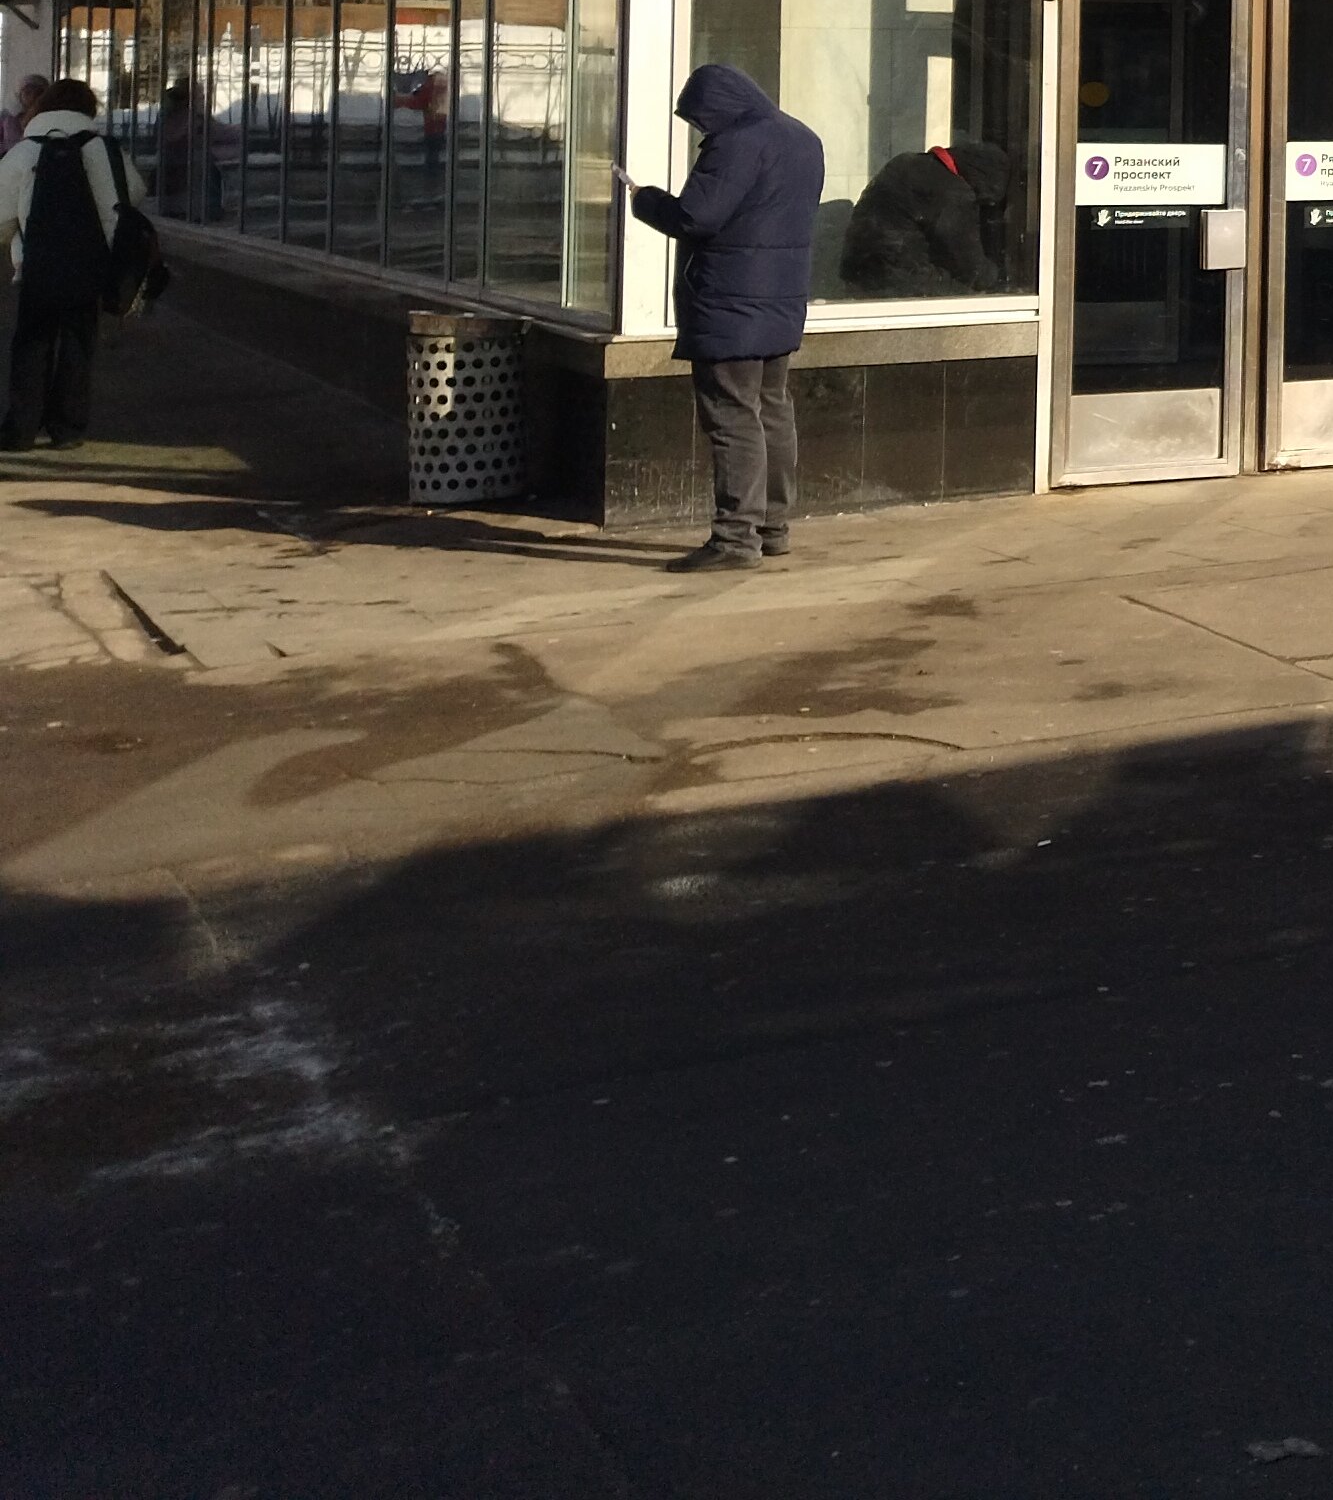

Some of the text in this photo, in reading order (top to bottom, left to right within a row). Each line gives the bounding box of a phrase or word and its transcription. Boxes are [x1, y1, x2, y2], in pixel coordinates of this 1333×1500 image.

[1114, 156, 1180, 167] Рязанский
[1113, 170, 1172, 181] проспект
[1159, 184, 1196, 192] Prospekt
